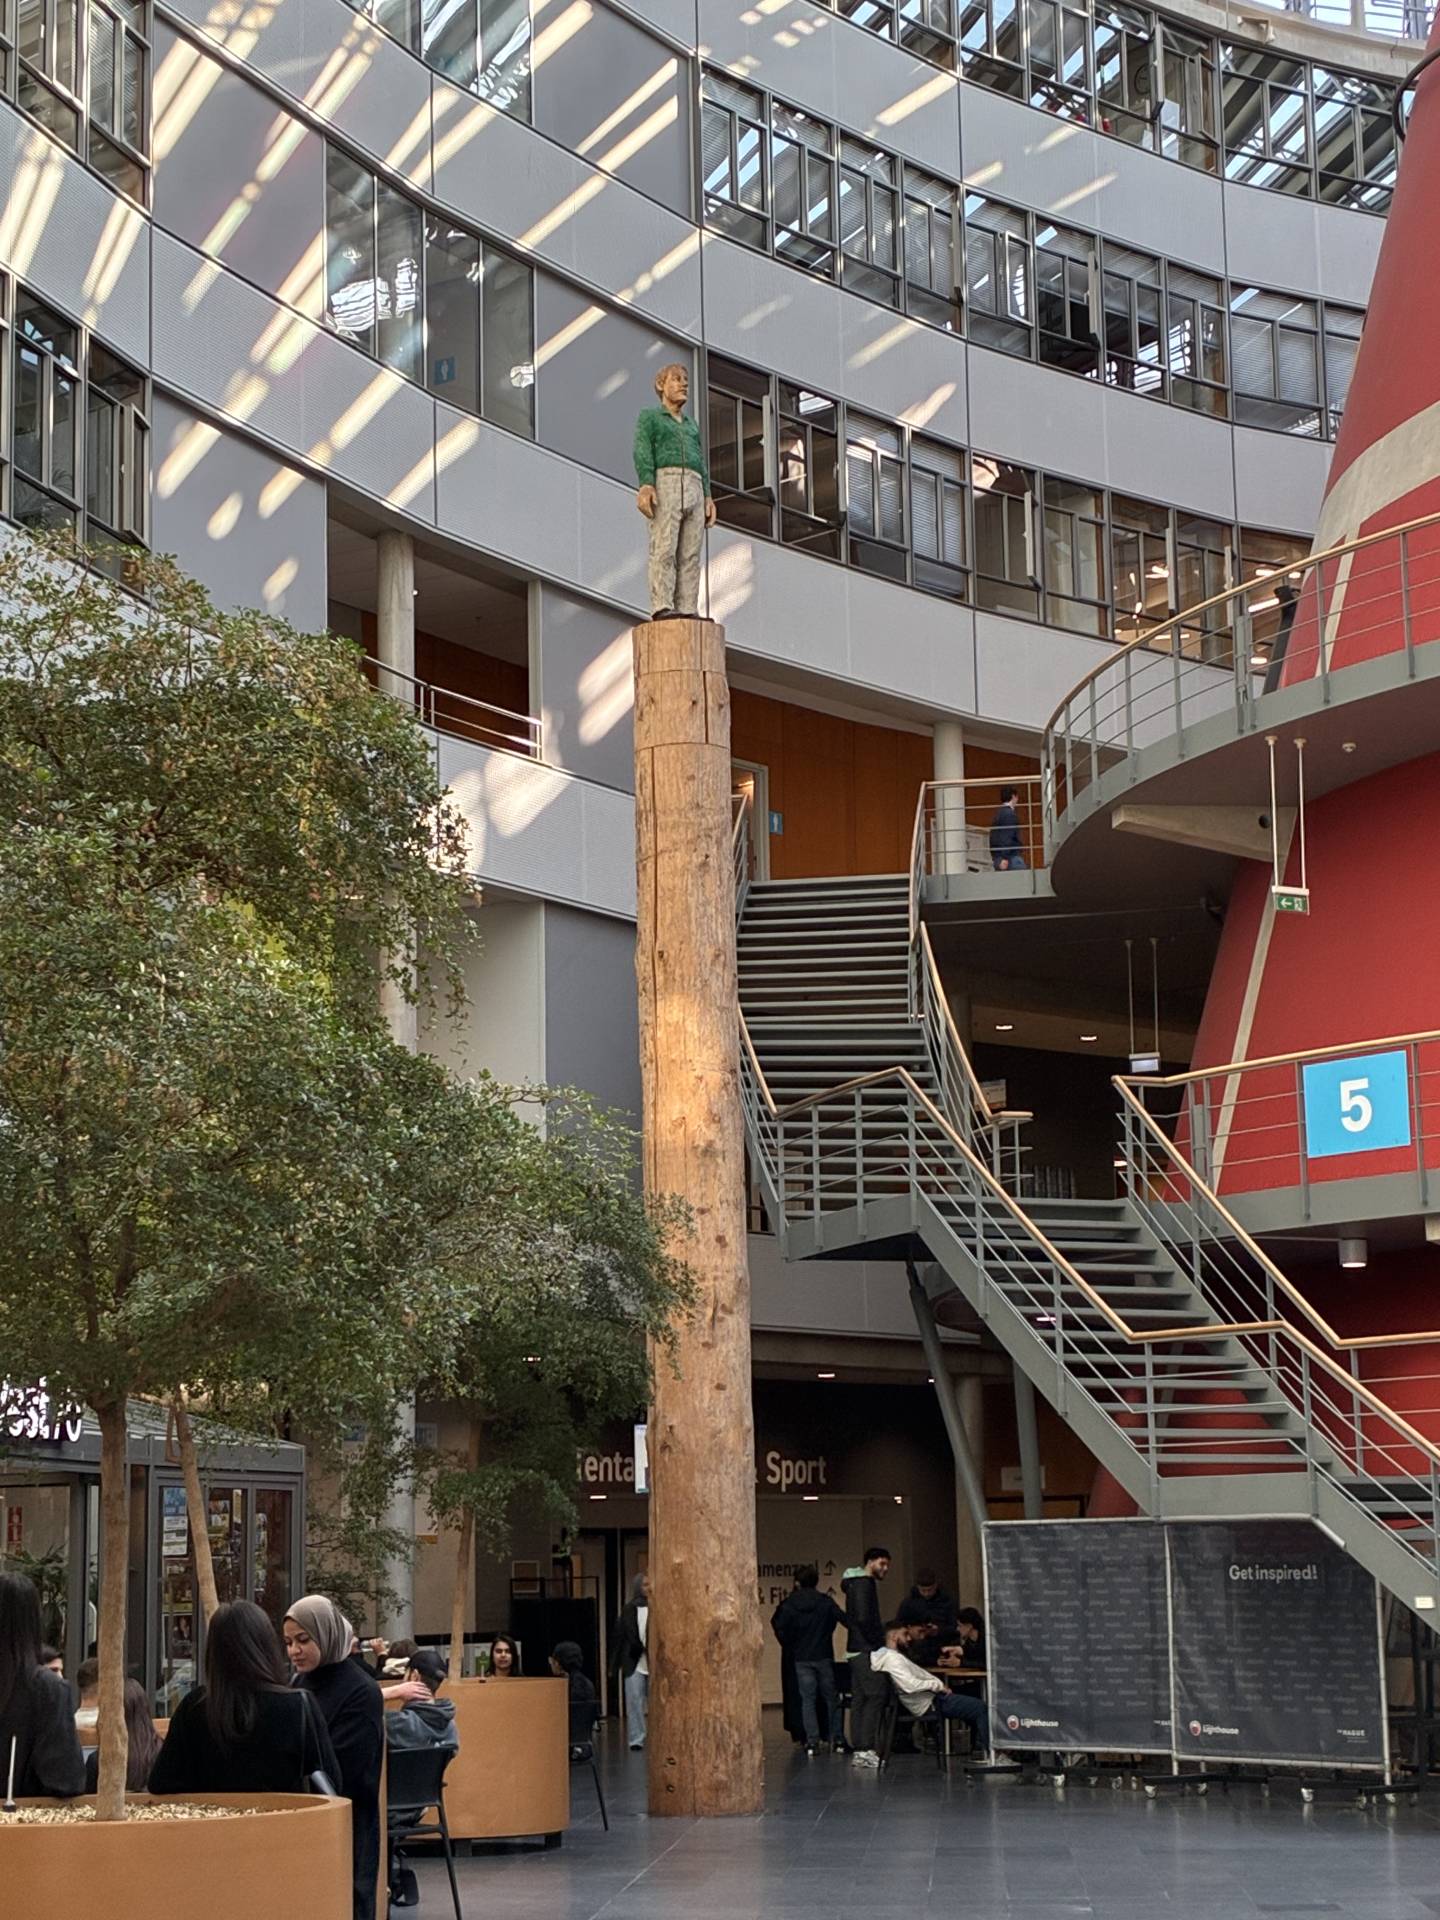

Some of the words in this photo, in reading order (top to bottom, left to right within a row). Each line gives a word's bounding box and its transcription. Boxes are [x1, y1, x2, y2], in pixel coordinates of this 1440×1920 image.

[1340, 1077, 1373, 1133] 5
[766, 1450, 827, 1493] Sport
[1228, 1564, 1254, 1580] Get
[1255, 1563, 1318, 1584] inspired!
